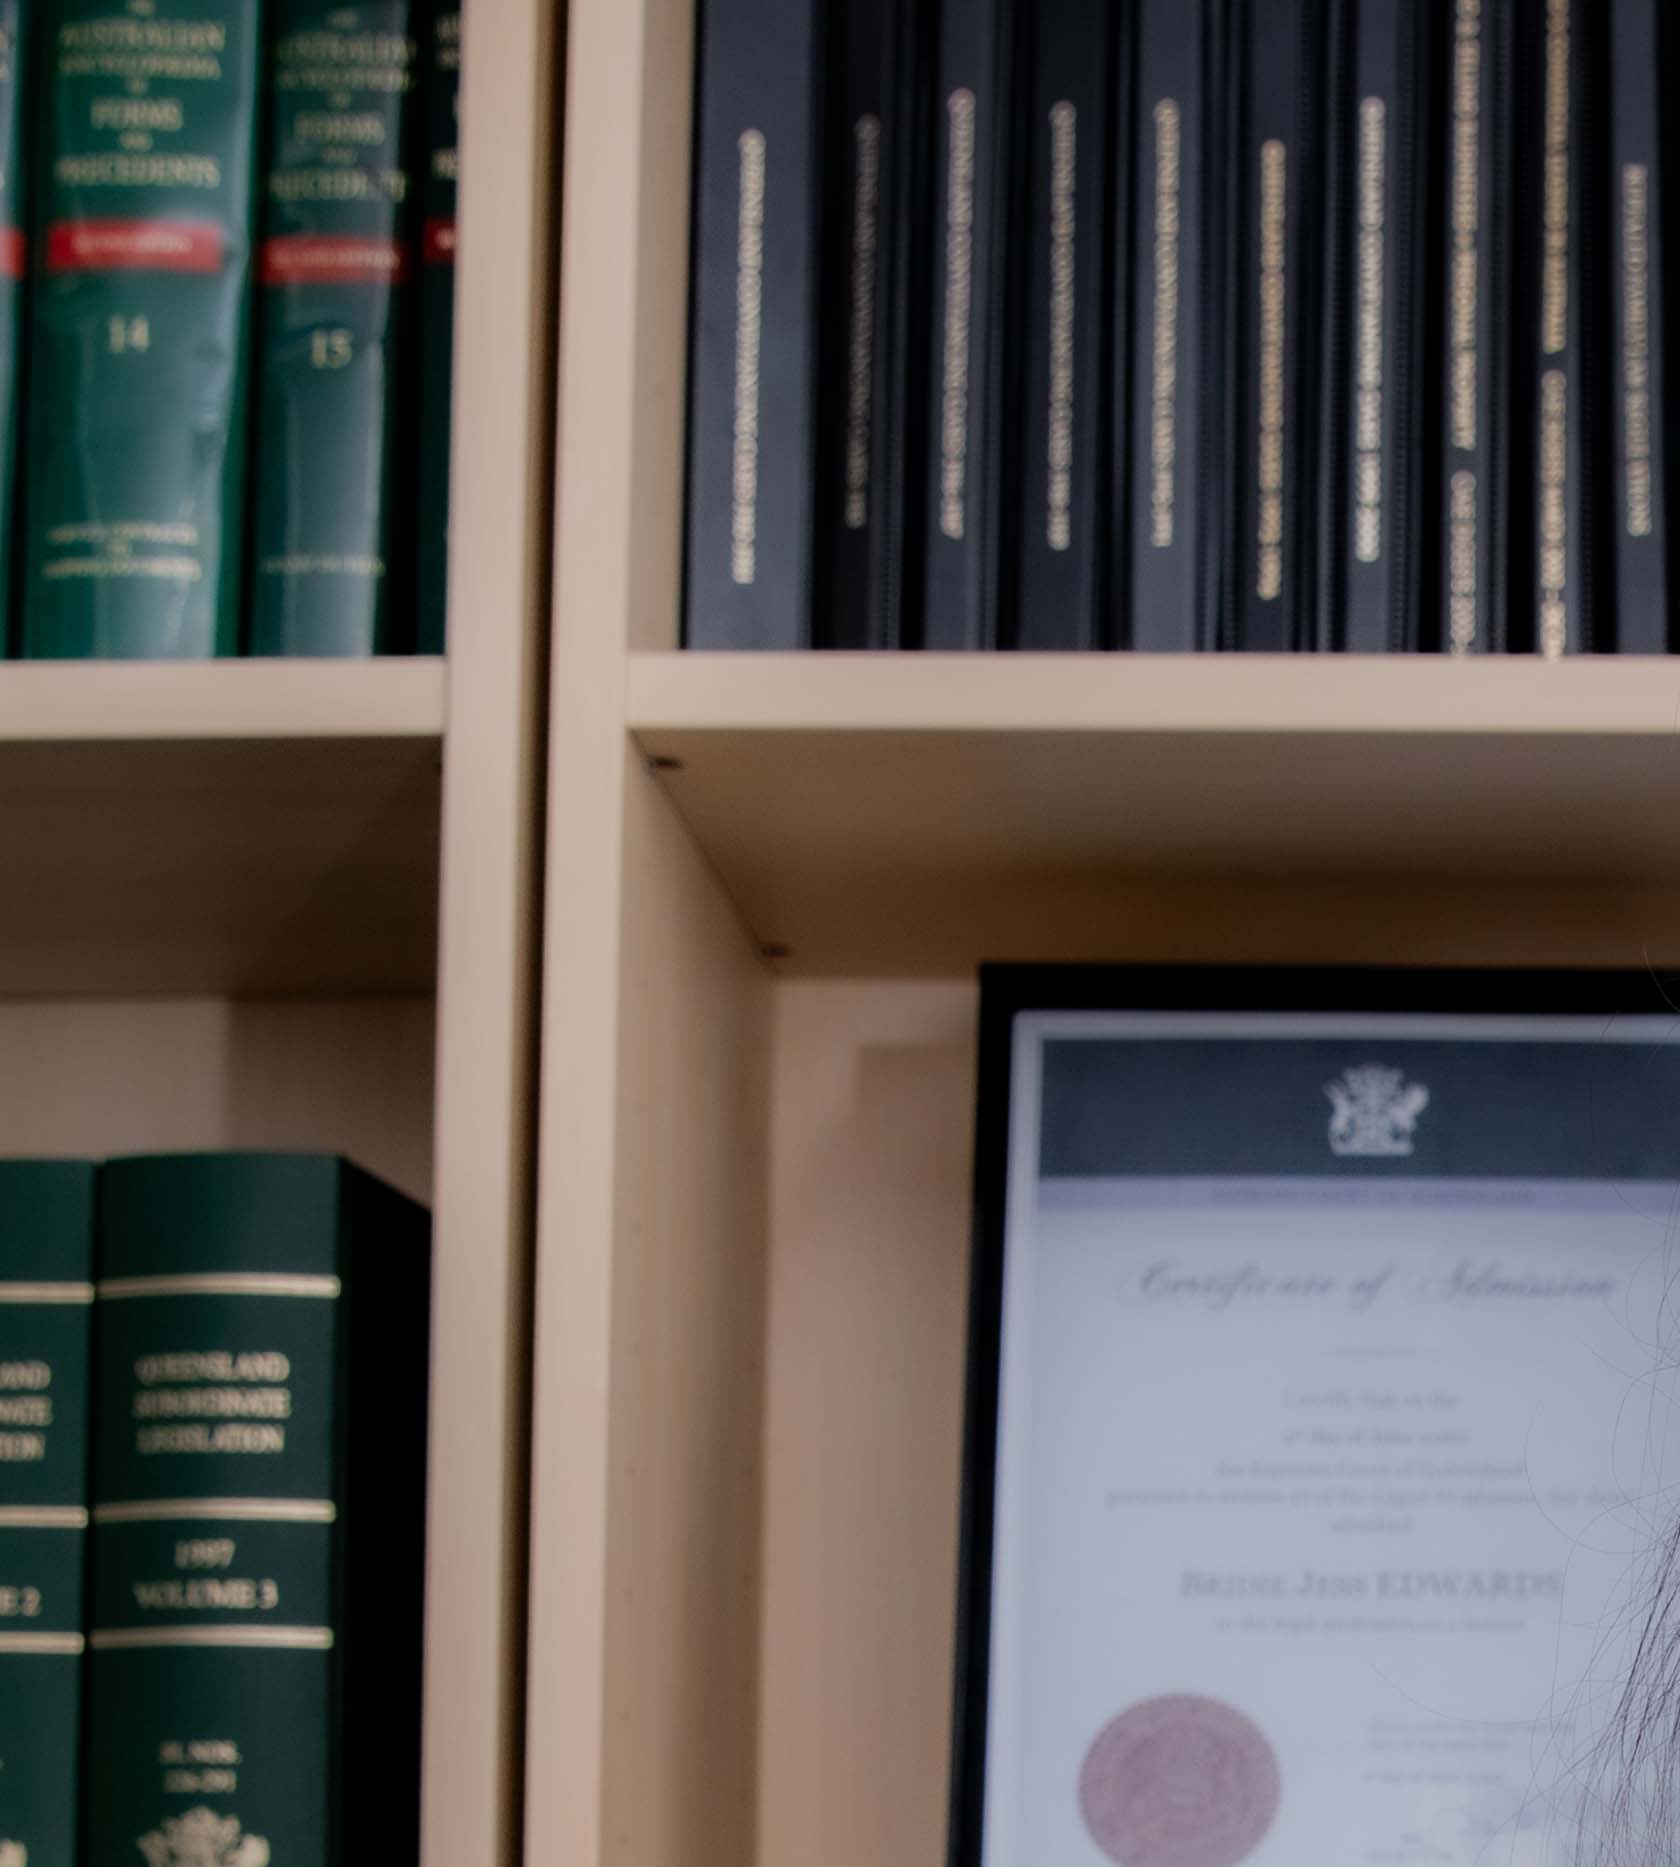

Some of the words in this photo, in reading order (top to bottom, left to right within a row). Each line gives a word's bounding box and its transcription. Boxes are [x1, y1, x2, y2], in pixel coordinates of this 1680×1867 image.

[107, 315, 150, 354] 14
[310, 330, 351, 369] 15
[1139, 1258, 1335, 1310] Certificate
[1348, 1264, 1388, 1312] of
[1418, 1258, 1615, 1300] Admission
[133, 1350, 290, 1385] QUEENSLAND
[136, 1423, 285, 1454] LEGISLATION
[174, 1538, 235, 1568] 1997
[133, 1578, 257, 1610] VOLUME
[258, 1578, 279, 1609] 3
[1378, 1570, 1560, 1599] EDWARDS
[21, 1586, 42, 1616] 2
